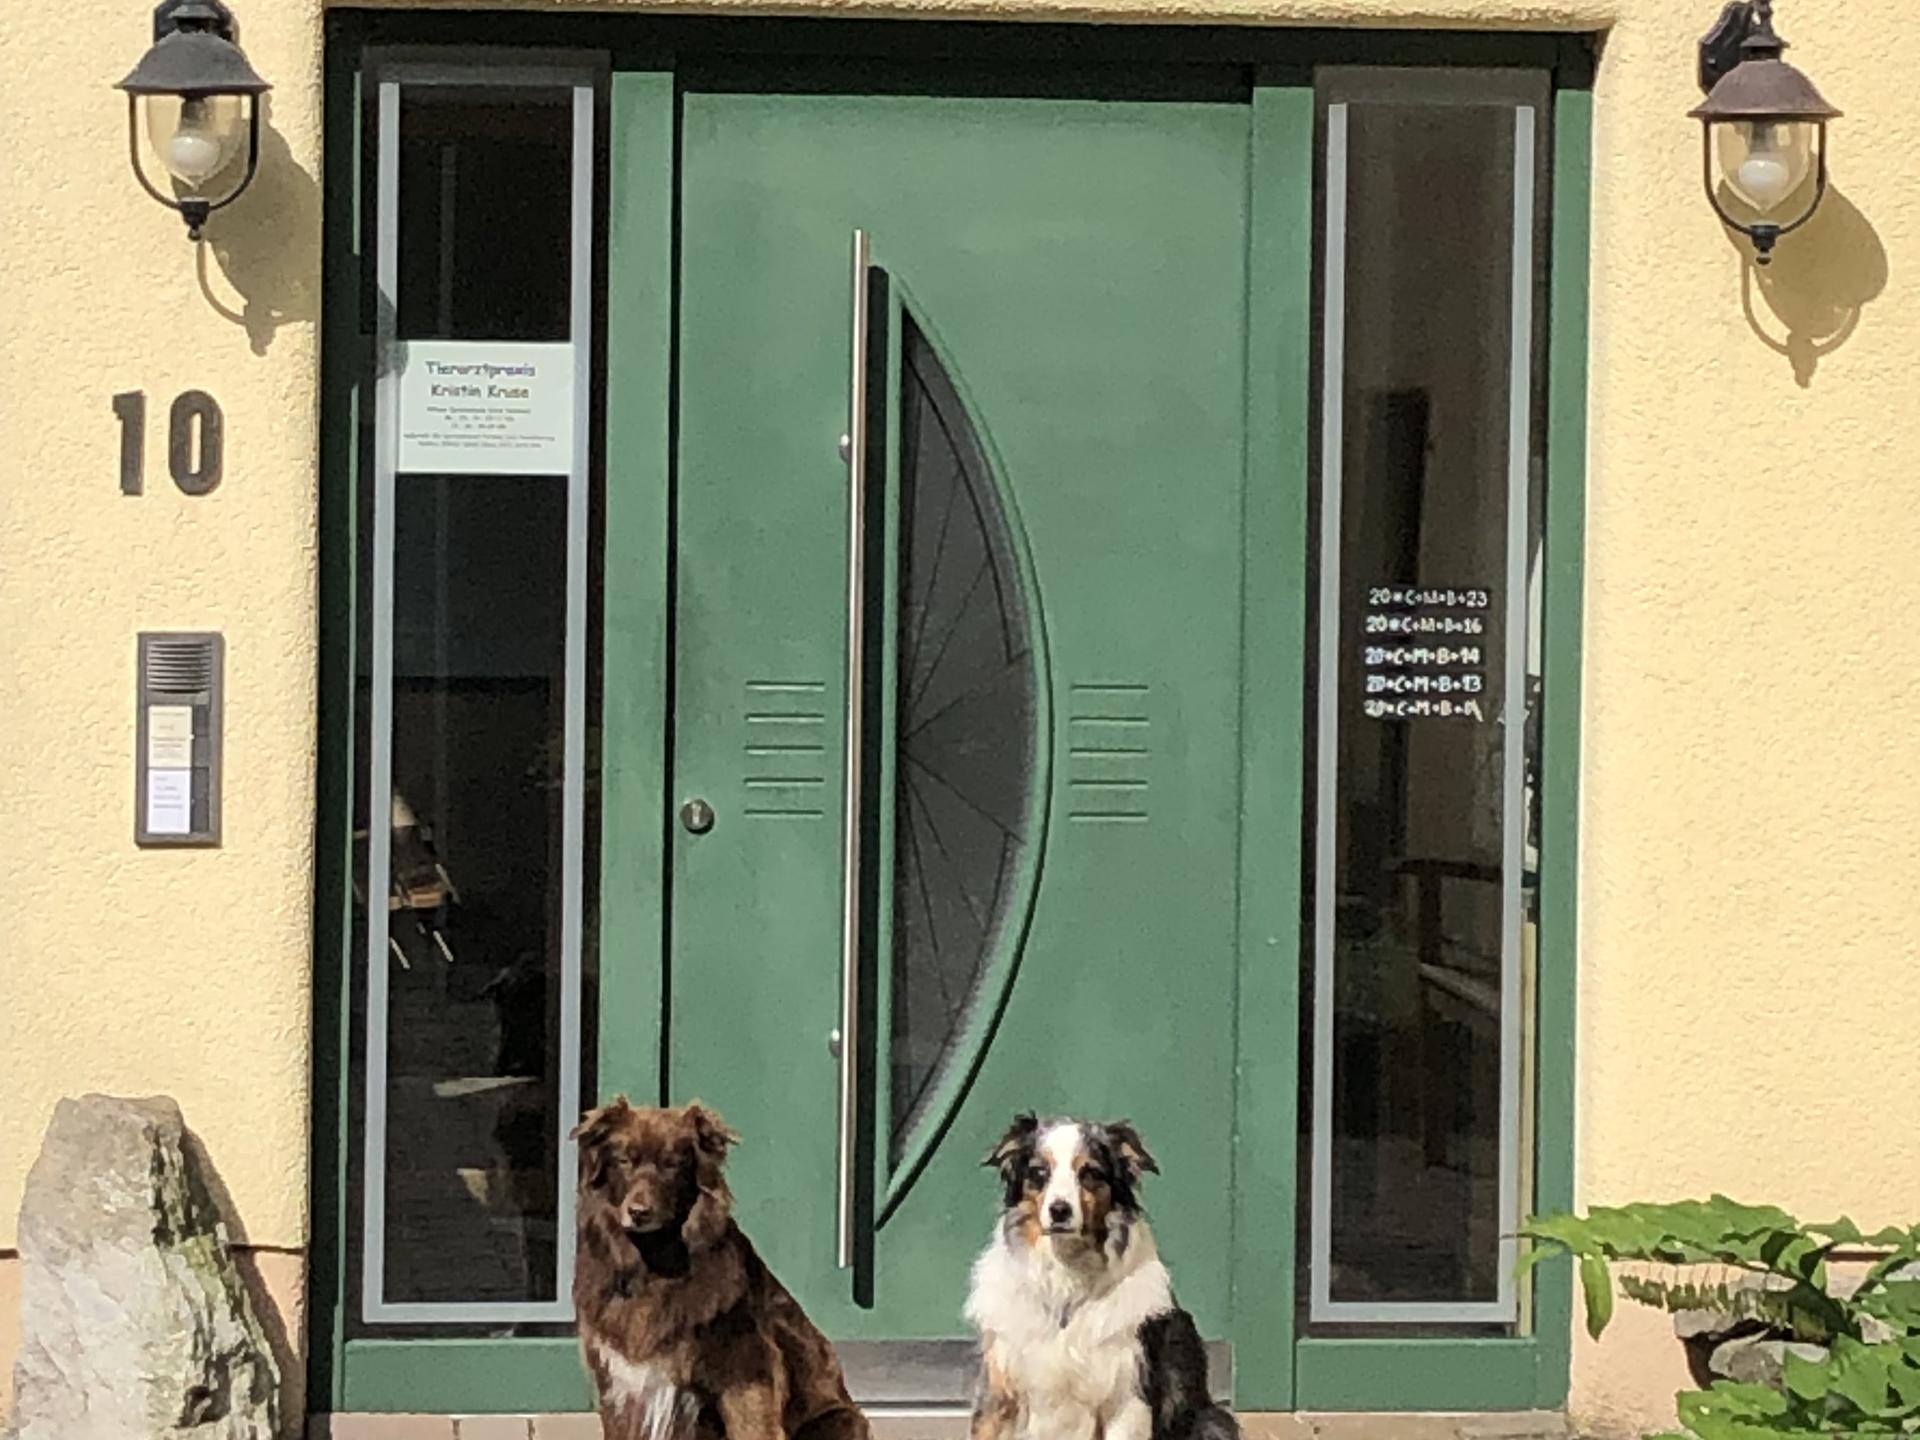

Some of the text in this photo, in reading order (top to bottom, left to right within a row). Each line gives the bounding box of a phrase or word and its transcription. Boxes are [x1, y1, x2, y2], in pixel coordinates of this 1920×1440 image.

[431, 384, 529, 398] Kristin Kruse
[112, 389, 224, 496] 10
